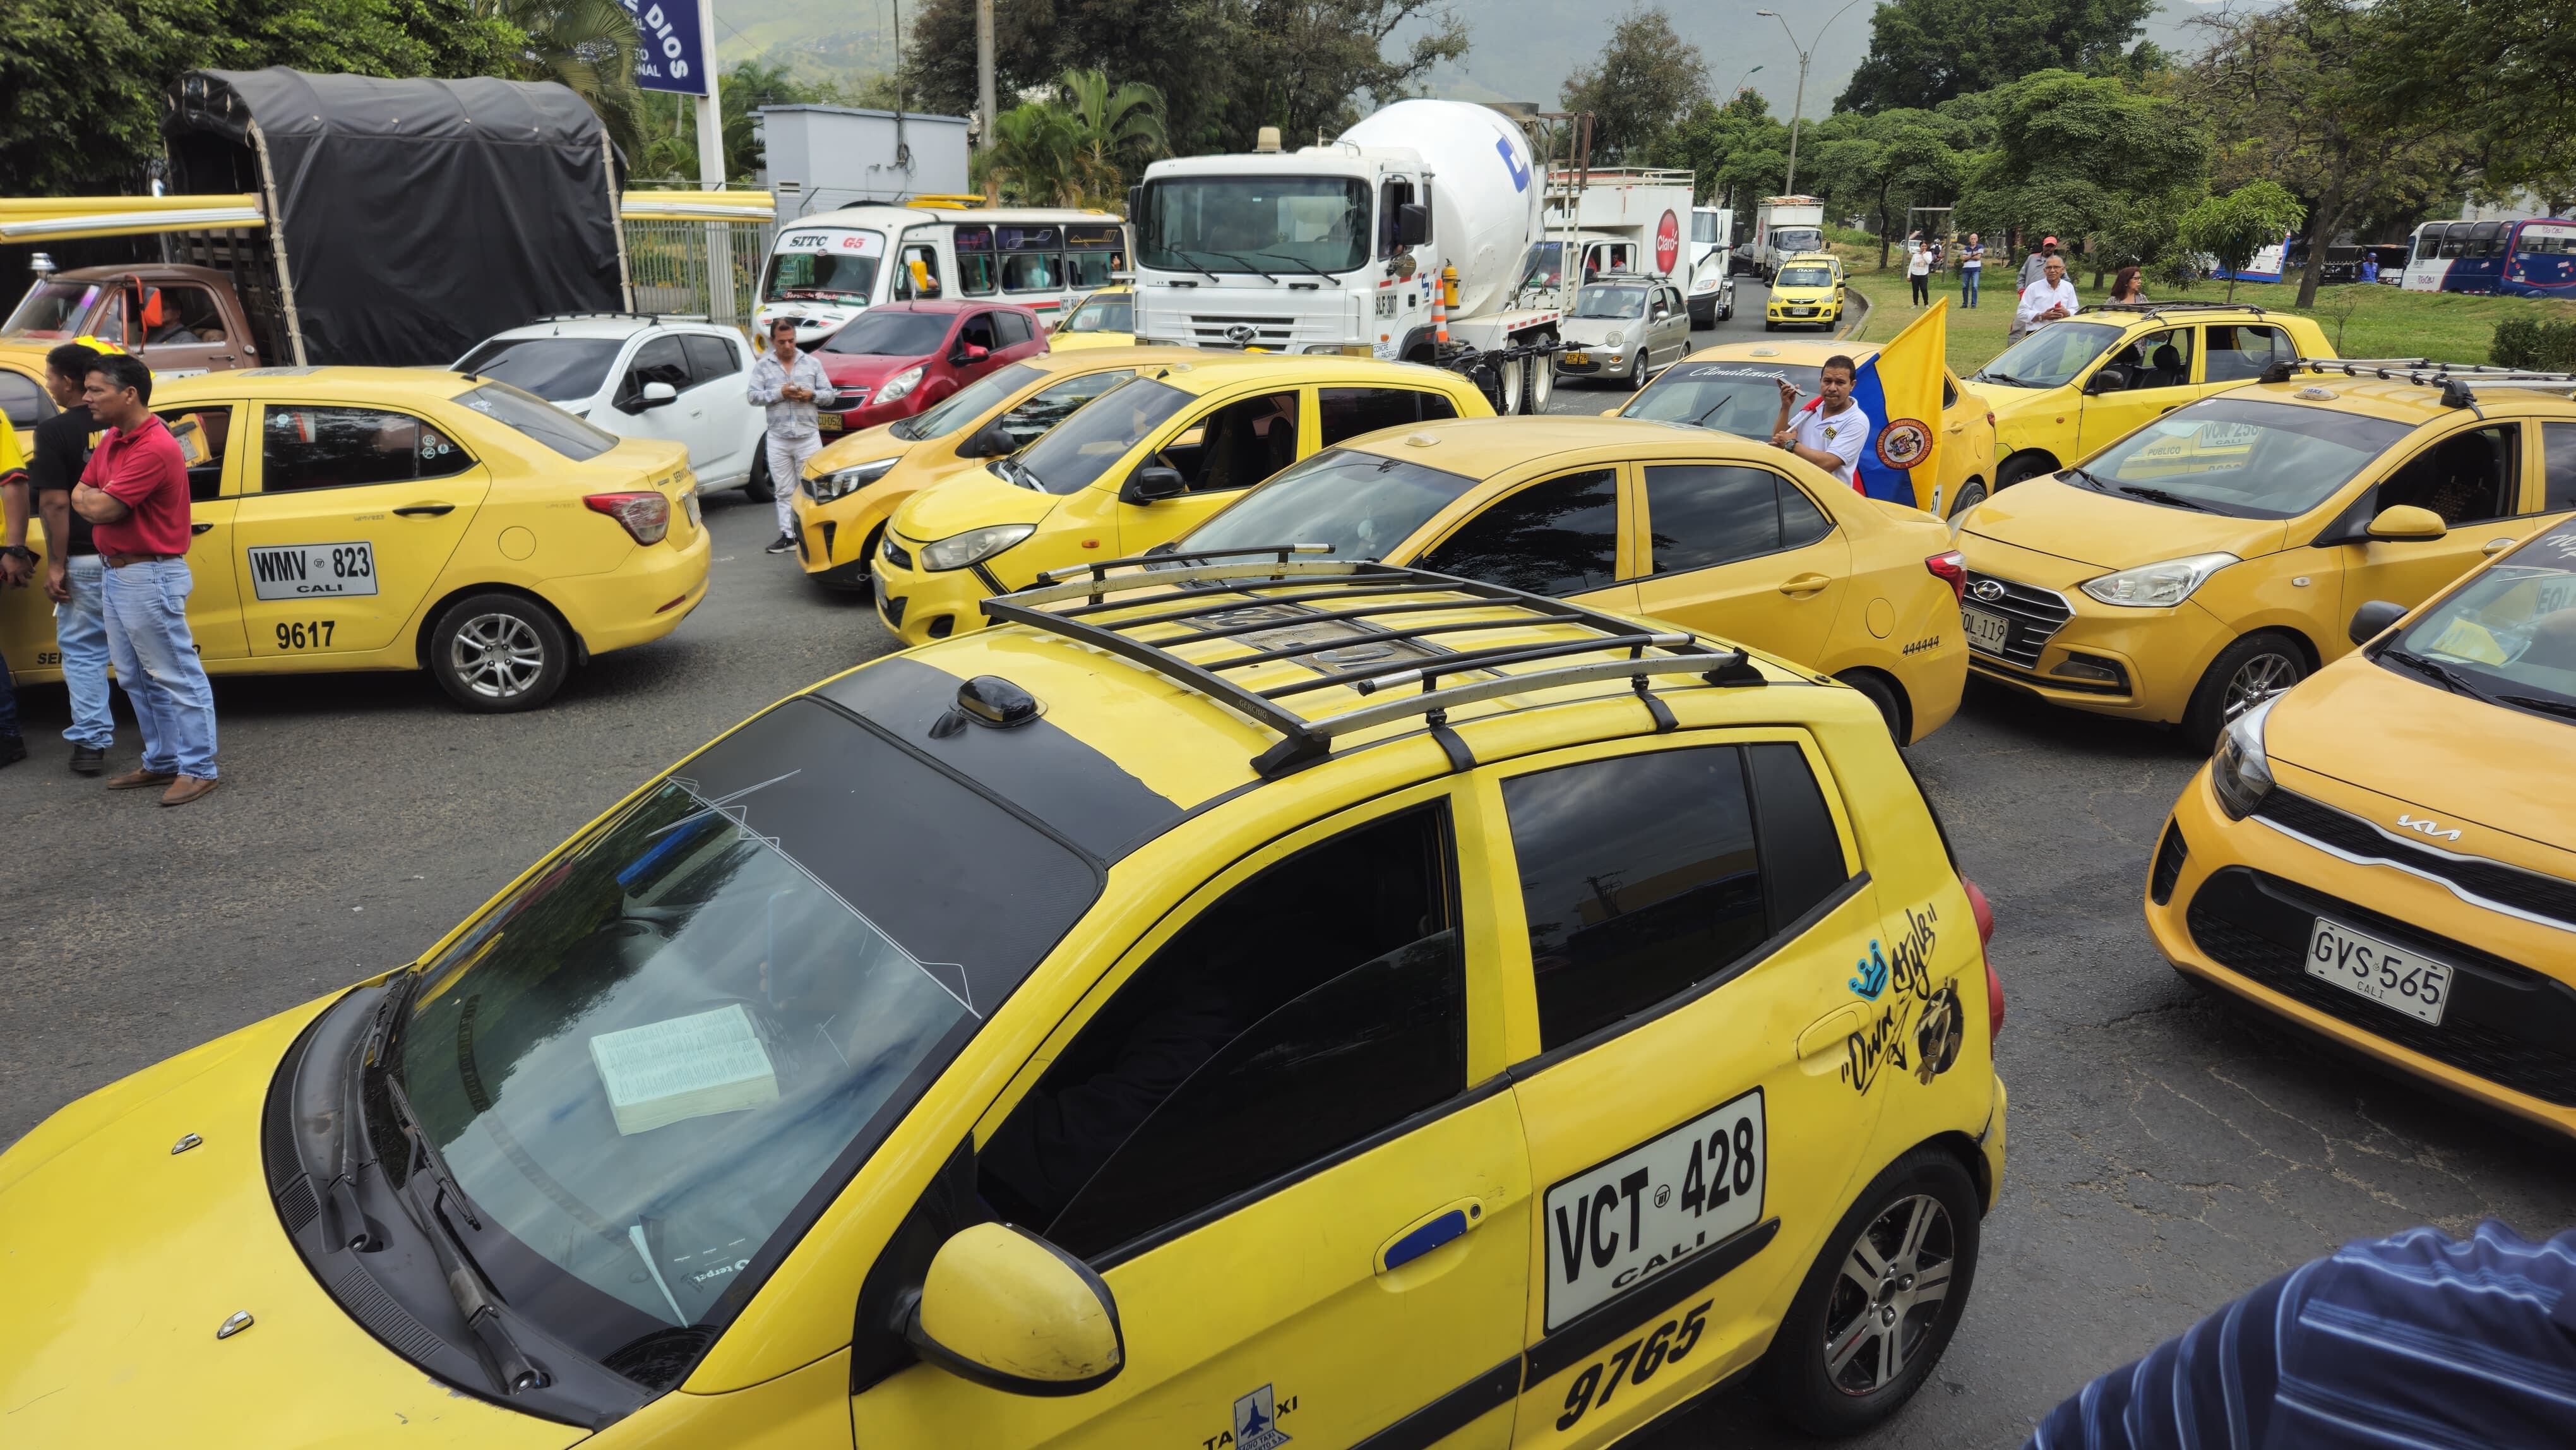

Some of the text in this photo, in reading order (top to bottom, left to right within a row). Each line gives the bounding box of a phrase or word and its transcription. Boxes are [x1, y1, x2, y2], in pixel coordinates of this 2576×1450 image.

[645, 3, 689, 79] DIOS
[789, 236, 866, 248] SITC G5
[1657, 234, 1674, 251] Claro
[1375, 294, 1397, 315] SLF 307
[1374, 344, 1388, 352] CONCRE
[1381, 350, 1397, 359] PACIFICO
[1689, 365, 1787, 379] Climatizado
[2147, 446, 2181, 457] PUBLICO
[254, 547, 370, 582] WMV 823
[296, 584, 343, 592] CALI
[275, 621, 335, 649] 9617
[1962, 613, 2005, 642] QL 119
[1902, 635, 1940, 656] 444444
[2397, 814, 2462, 842] KIA
[2315, 932, 2444, 1005] GVS 565
[2357, 981, 2385, 999] CALI
[1555, 1117, 1755, 1285] VCT 428
[1611, 1230, 1706, 1289] CALI
[694, 1266, 733, 1282] terpel
[1555, 1298, 1715, 1432] 9765
[1237, 1440, 1258, 1450] ADIO
